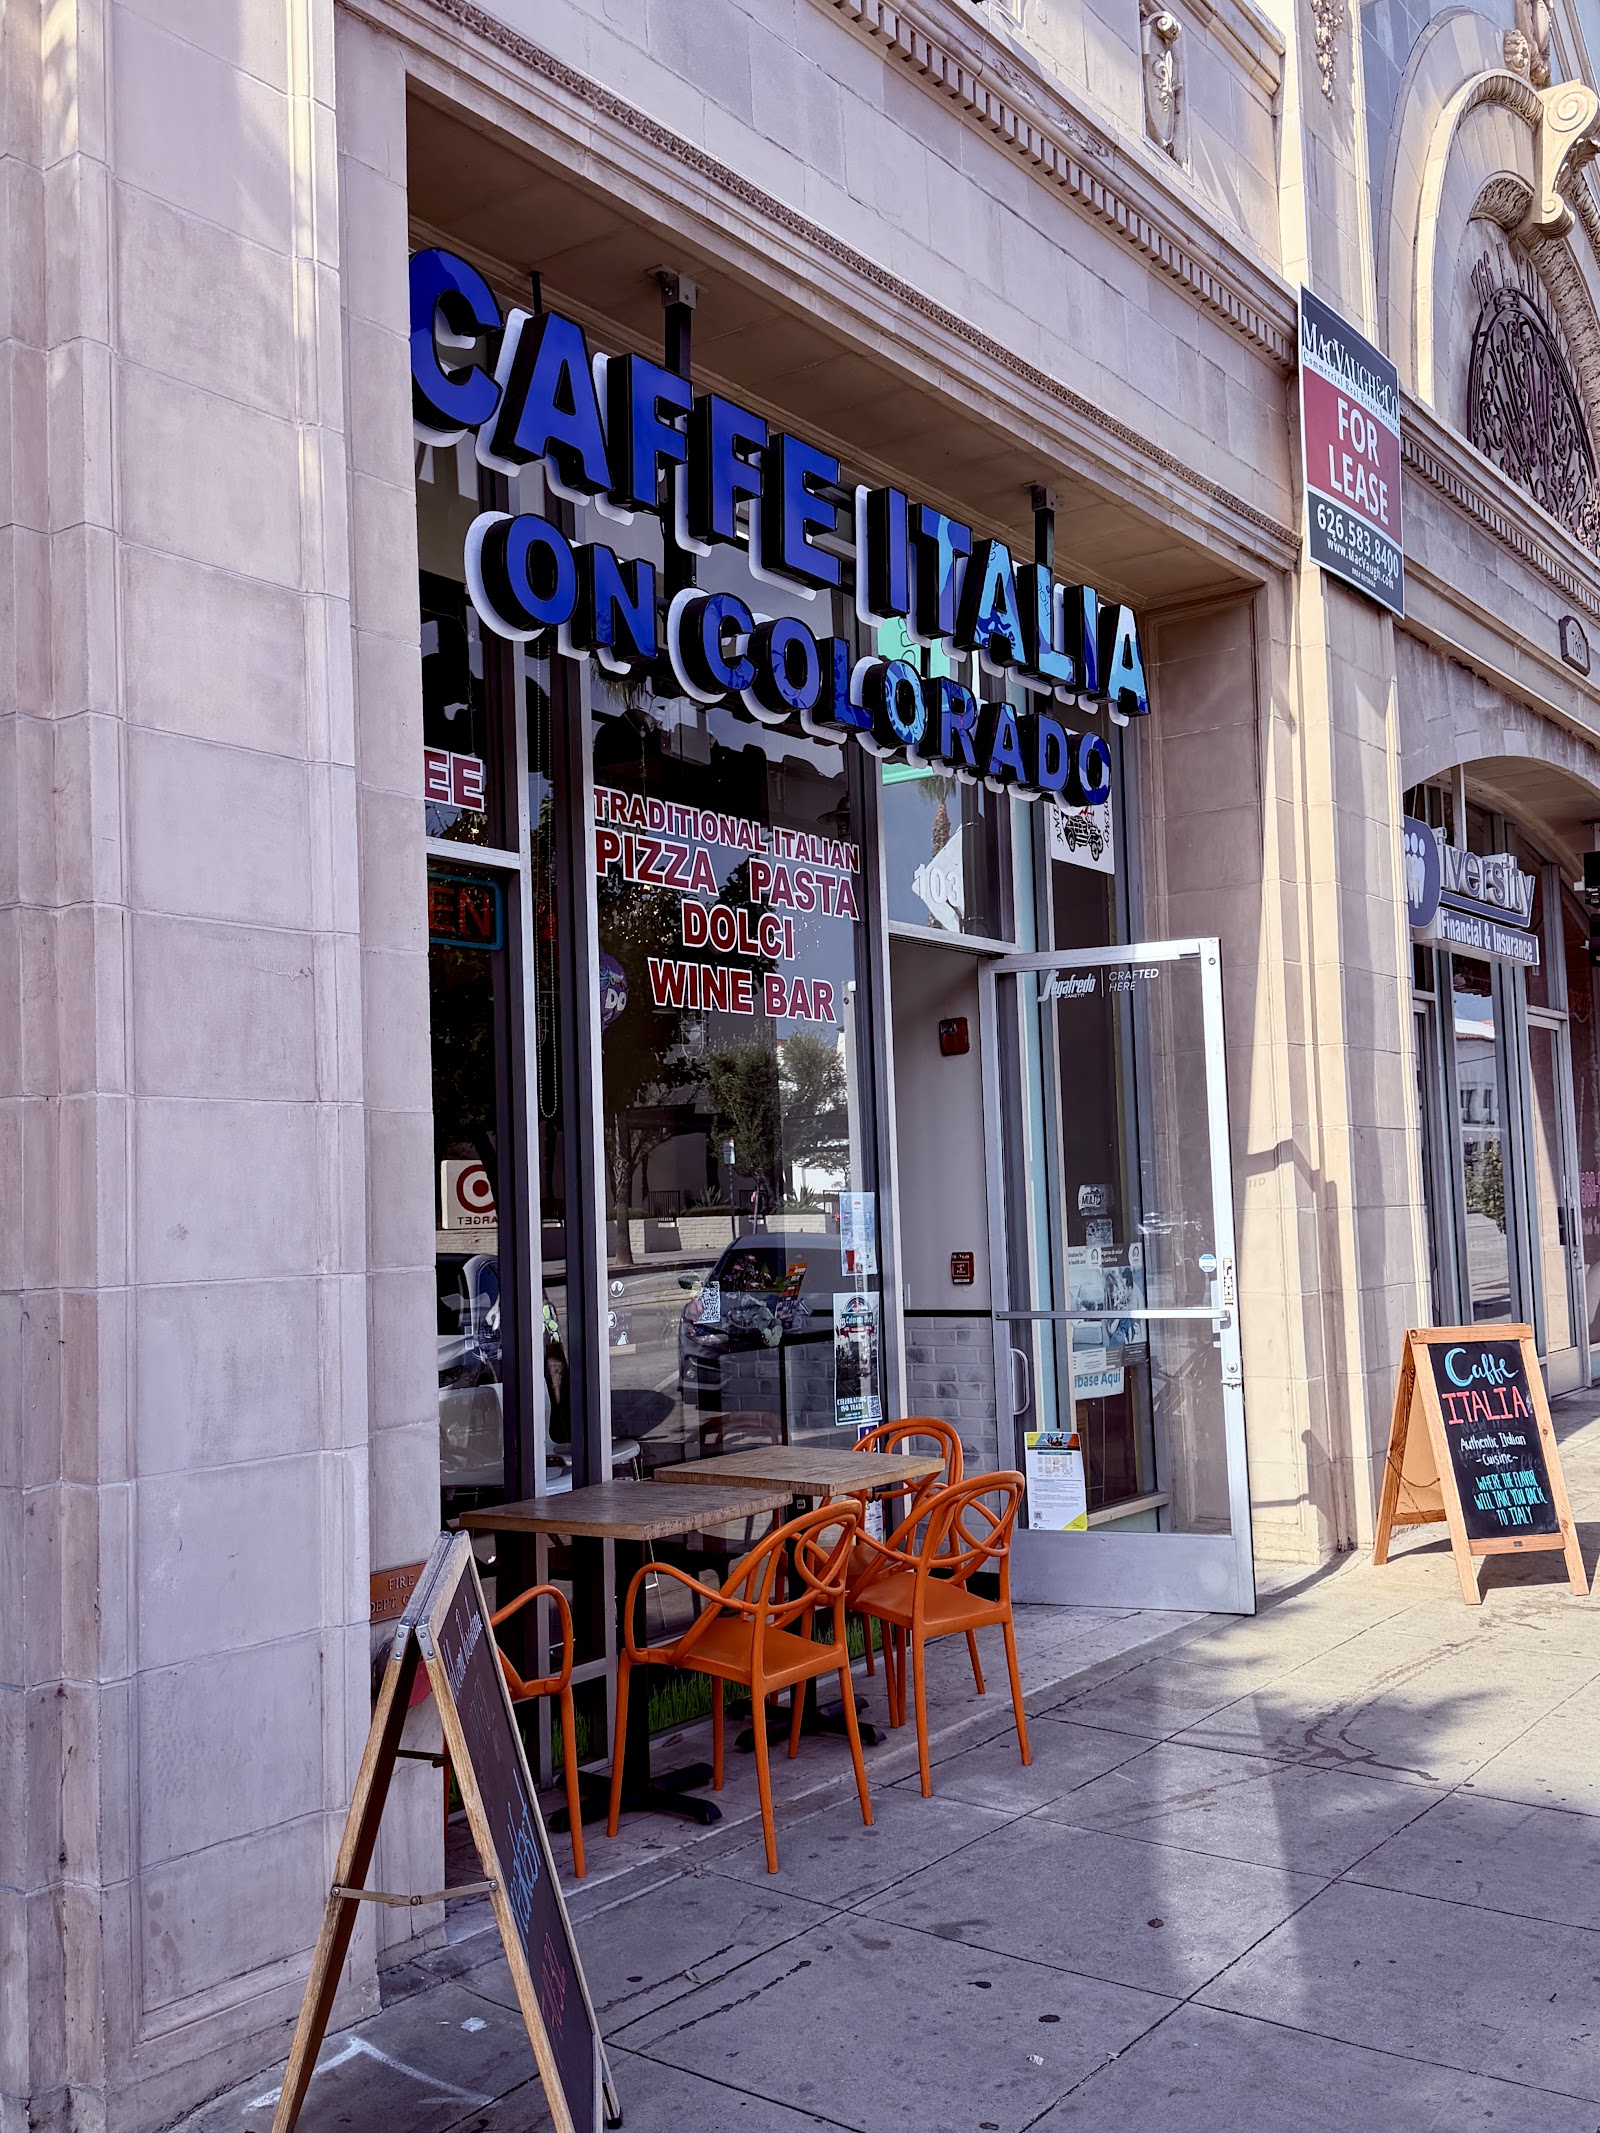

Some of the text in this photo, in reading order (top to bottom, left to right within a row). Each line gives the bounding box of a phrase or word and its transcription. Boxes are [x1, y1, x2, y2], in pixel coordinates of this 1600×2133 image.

[1303, 351, 1343, 387] Commercial
[1345, 381, 1359, 399] Real
[1361, 394, 1378, 414] Estate
[1337, 396, 1380, 467] FOR
[408, 248, 1150, 716] CAFFE ITALIA
[1328, 443, 1389, 526] LEASE
[1317, 503, 1399, 579] 626.583.8400
[1327, 538, 1394, 590] www.MacVaugh.com
[482, 513, 1112, 806] ON COLORADO
[594, 785, 861, 875] TRADITIONAL ITALIAN
[595, 826, 861, 922] PIZZA PASTA
[681, 898, 796, 961] DOLCI
[1441, 909, 1533, 962] Financial & Insurance
[647, 956, 838, 1024] WINE BAR
[1037, 968, 1160, 1002] Segafredo CRAFTED
[1108, 981, 1137, 992] HERE
[1444, 1347, 1519, 1387] Caffe
[1441, 1385, 1530, 1425] ITALIA
[1460, 1431, 1527, 1452] Authentic Italian
[1473, 1486, 1549, 1511] WILL TAKE YOU BACK
[1475, 1469, 1539, 1491] WHERE THE FLAVOR
[1496, 1505, 1534, 1526] TO ITALY
[388, 1573, 415, 1591] FIRE
